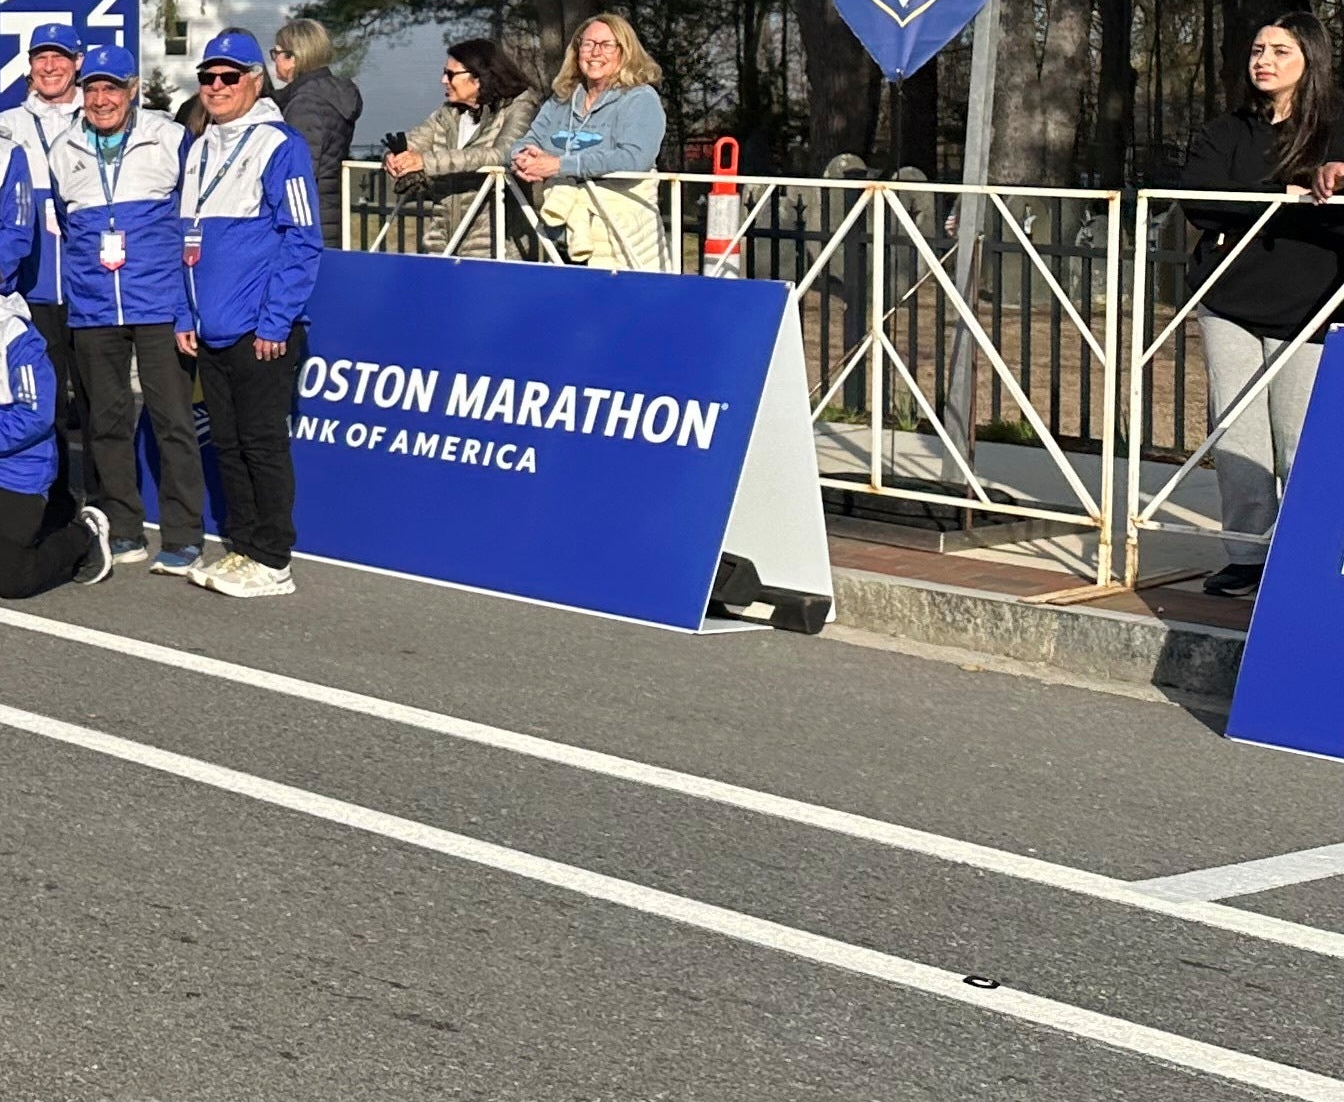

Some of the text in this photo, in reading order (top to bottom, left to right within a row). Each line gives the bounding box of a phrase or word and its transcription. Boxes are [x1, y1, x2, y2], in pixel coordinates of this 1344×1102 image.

[445, 373, 722, 450] MARATHON
[345, 423, 388, 450] OF
[389, 429, 537, 474] AMERICA
